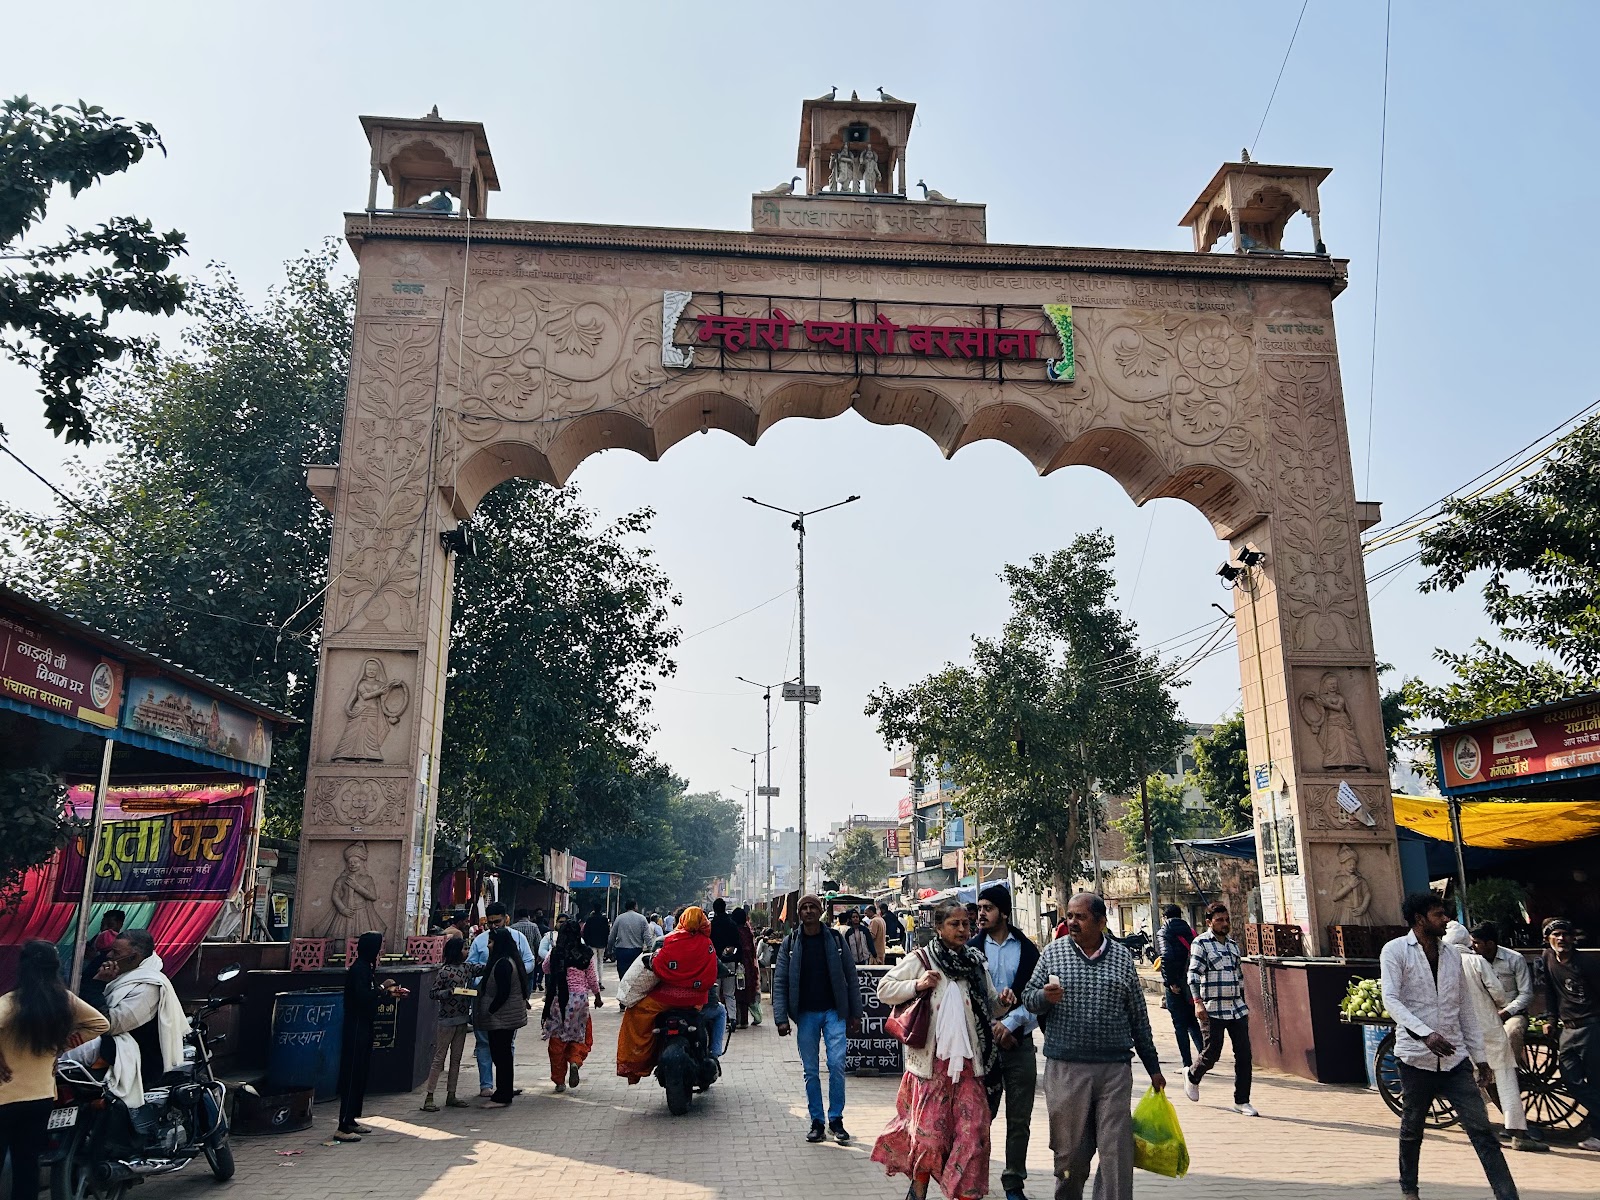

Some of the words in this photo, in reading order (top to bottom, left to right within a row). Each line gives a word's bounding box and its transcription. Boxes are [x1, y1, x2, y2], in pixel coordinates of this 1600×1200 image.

[754, 200, 781, 226] श्री
[783, 204, 877, 228] राधारानी
[885, 207, 942, 232] मंदिर
[697, 308, 796, 354] म्हारो
[803, 313, 900, 357] प्यारो
[907, 324, 1041, 360] बरसाना
[35, 662, 69, 689] विश्राम
[69, 678, 85, 695] घर
[39, 690, 73, 711] बरसाना
[1576, 751, 1596, 763] नगर
[171, 818, 233, 861] घर
[278, 1029, 327, 1049] बरसाना
[873, 1038, 899, 1055] वाहन
